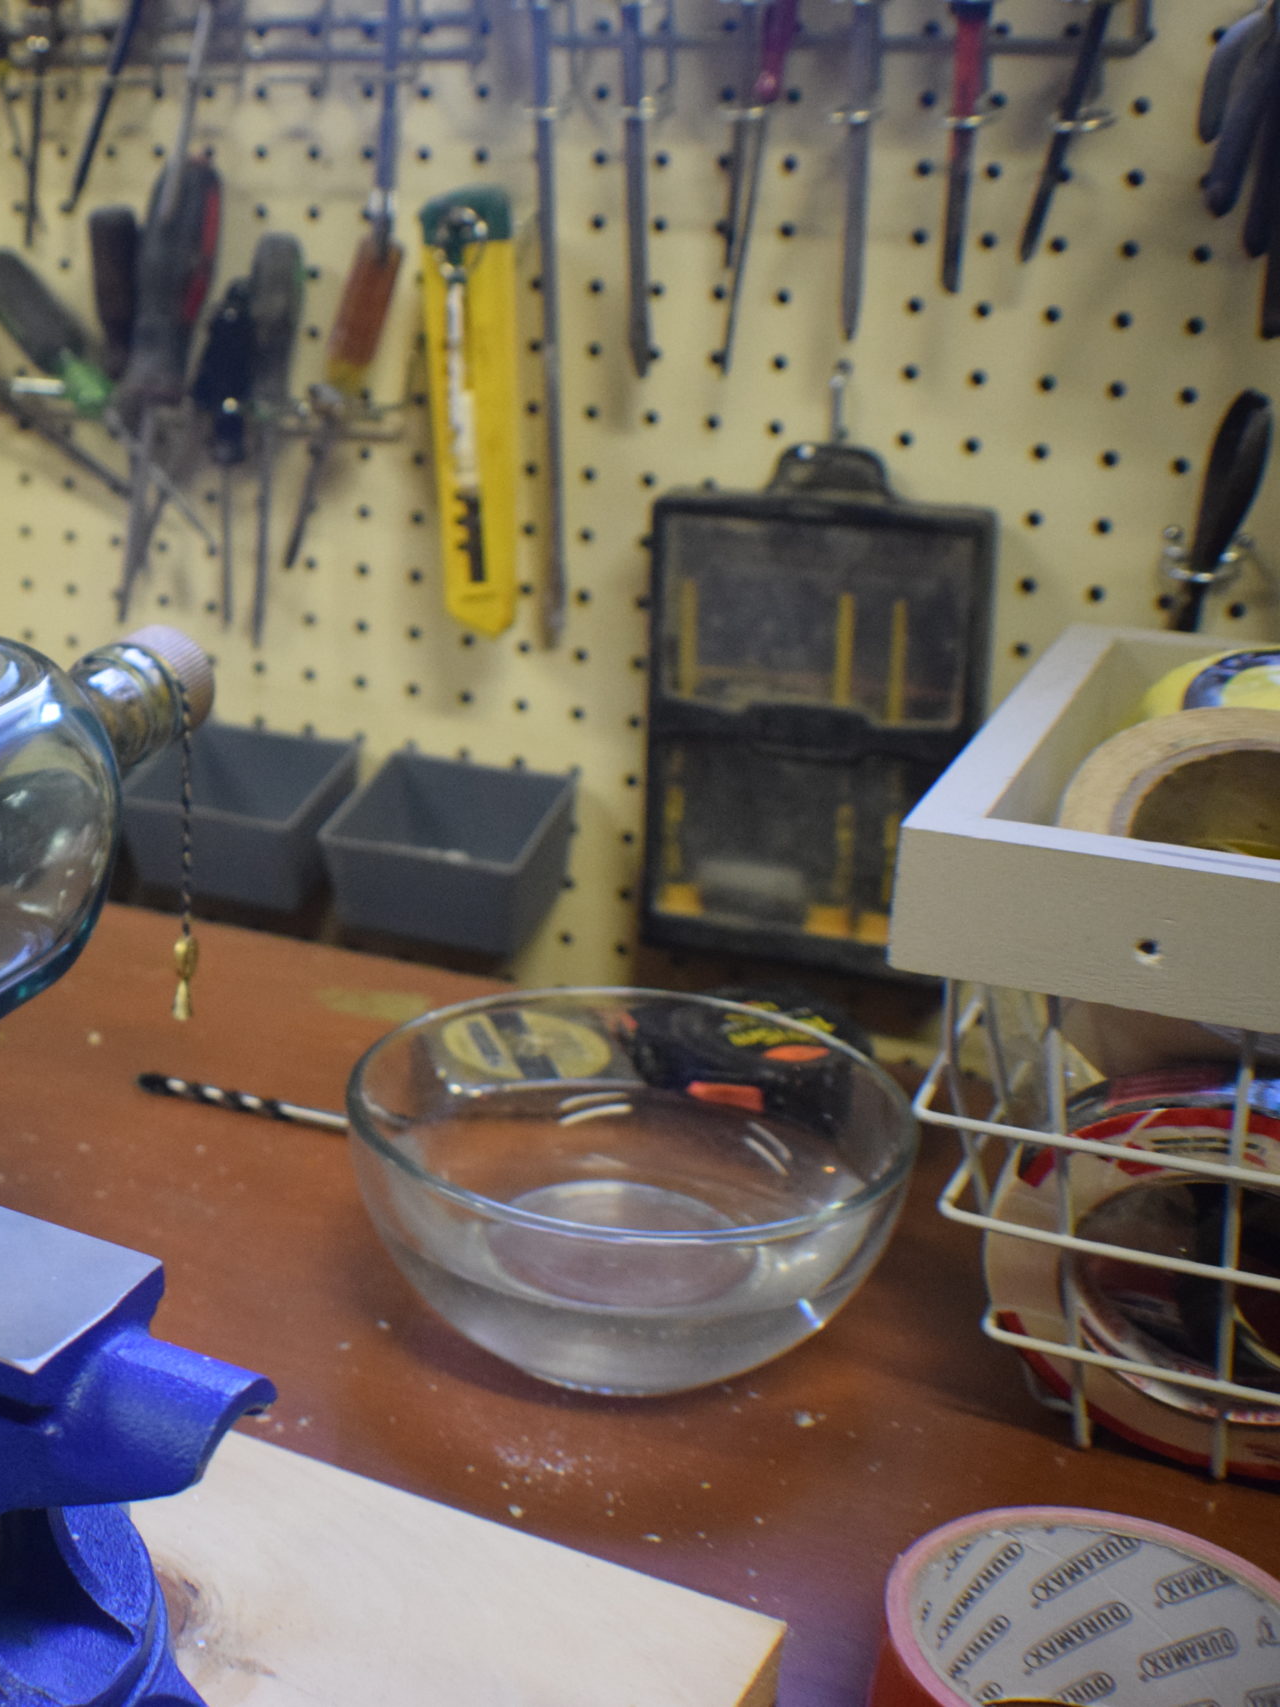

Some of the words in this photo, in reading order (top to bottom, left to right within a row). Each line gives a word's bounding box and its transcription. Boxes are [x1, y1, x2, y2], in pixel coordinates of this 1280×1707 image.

[938, 1542, 1021, 1638] DURAMAX
[1034, 1535, 1138, 1599] DURAMAX
[1026, 1603, 1128, 1668] DURAMAX
[1144, 1631, 1235, 1676] DURAMAX
